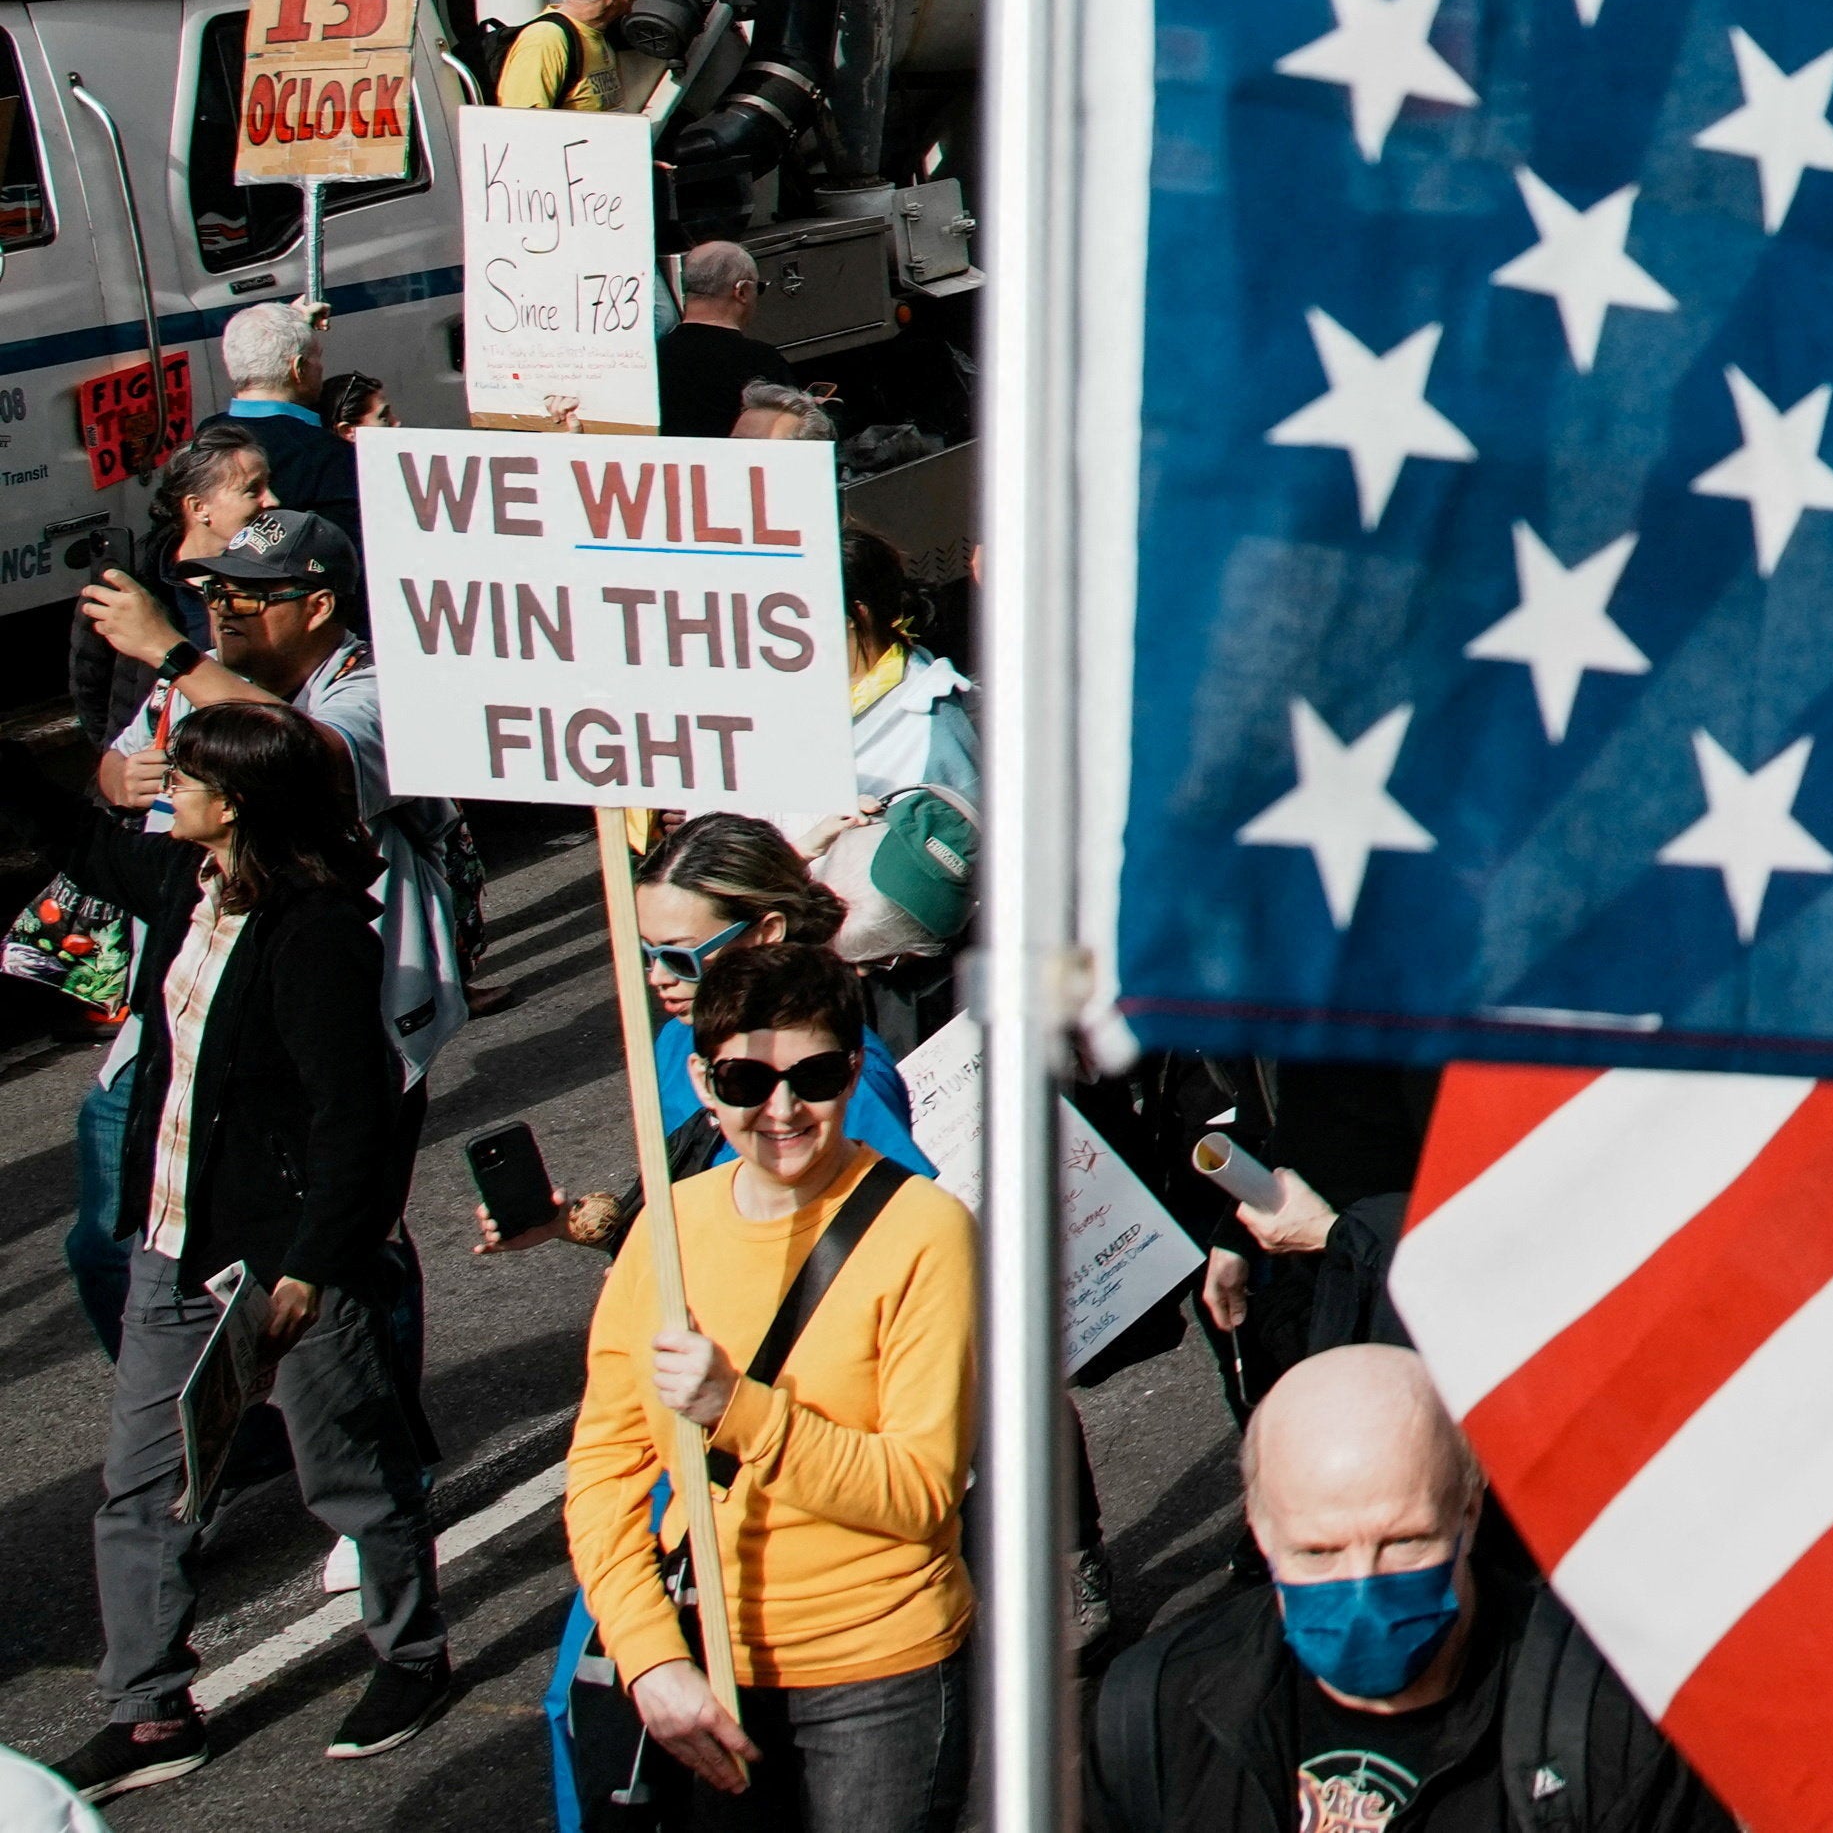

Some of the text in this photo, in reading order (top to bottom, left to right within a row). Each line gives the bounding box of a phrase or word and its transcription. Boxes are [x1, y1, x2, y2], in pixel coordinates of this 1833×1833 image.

[247, 69, 404, 146] O'CLOCK
[483, 139, 625, 254] King Free
[485, 258, 560, 333] Since
[92, 359, 188, 413] FIGT
[2, 464, 49, 485] Transit
[398, 452, 803, 546] WE WILL
[399, 578, 815, 673] WIN THIS
[485, 704, 754, 791] FIGHT
[1094, 1223, 1142, 1267] EXALTED
[1078, 1312, 1121, 1343] KINGS
